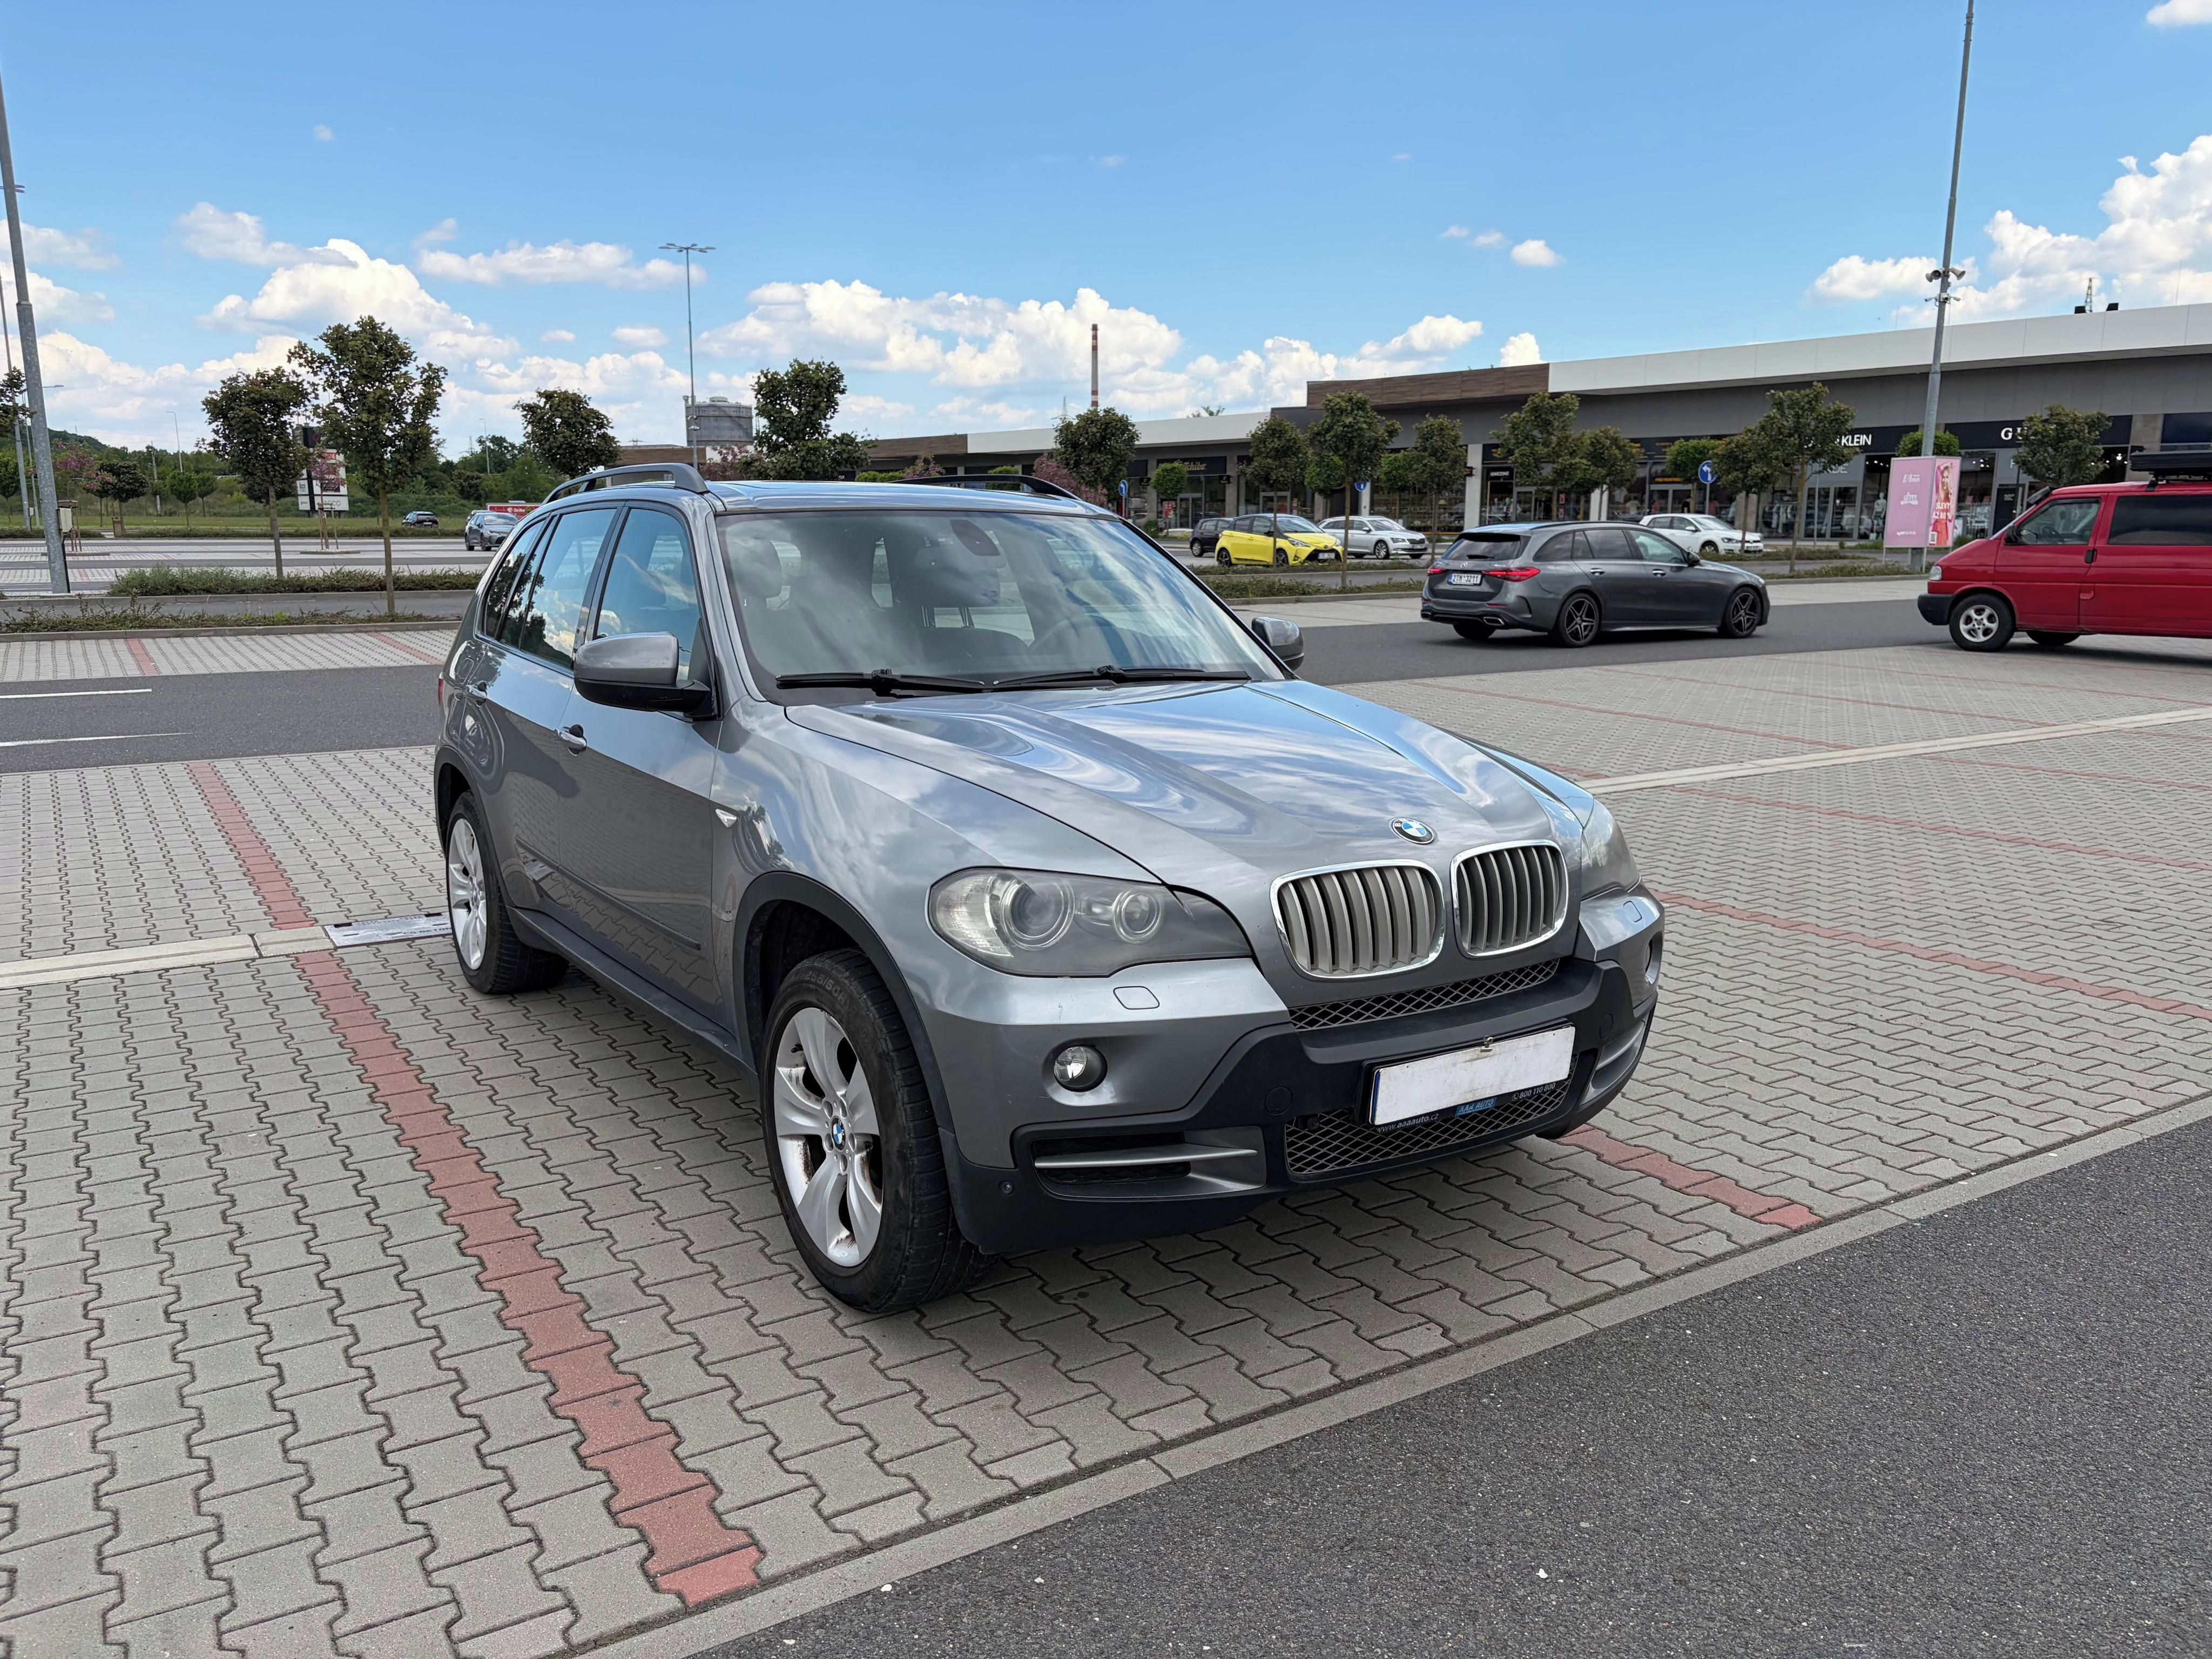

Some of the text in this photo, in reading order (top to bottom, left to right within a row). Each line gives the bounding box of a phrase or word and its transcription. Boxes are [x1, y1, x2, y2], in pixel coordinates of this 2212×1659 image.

[1841, 434, 1872, 446] KLEIN
[1519, 1082, 1556, 1098] 800 110 800
[1476, 1098, 1494, 1109] AUTO
[1377, 1114, 1439, 1132] www.aaaauto.cz
